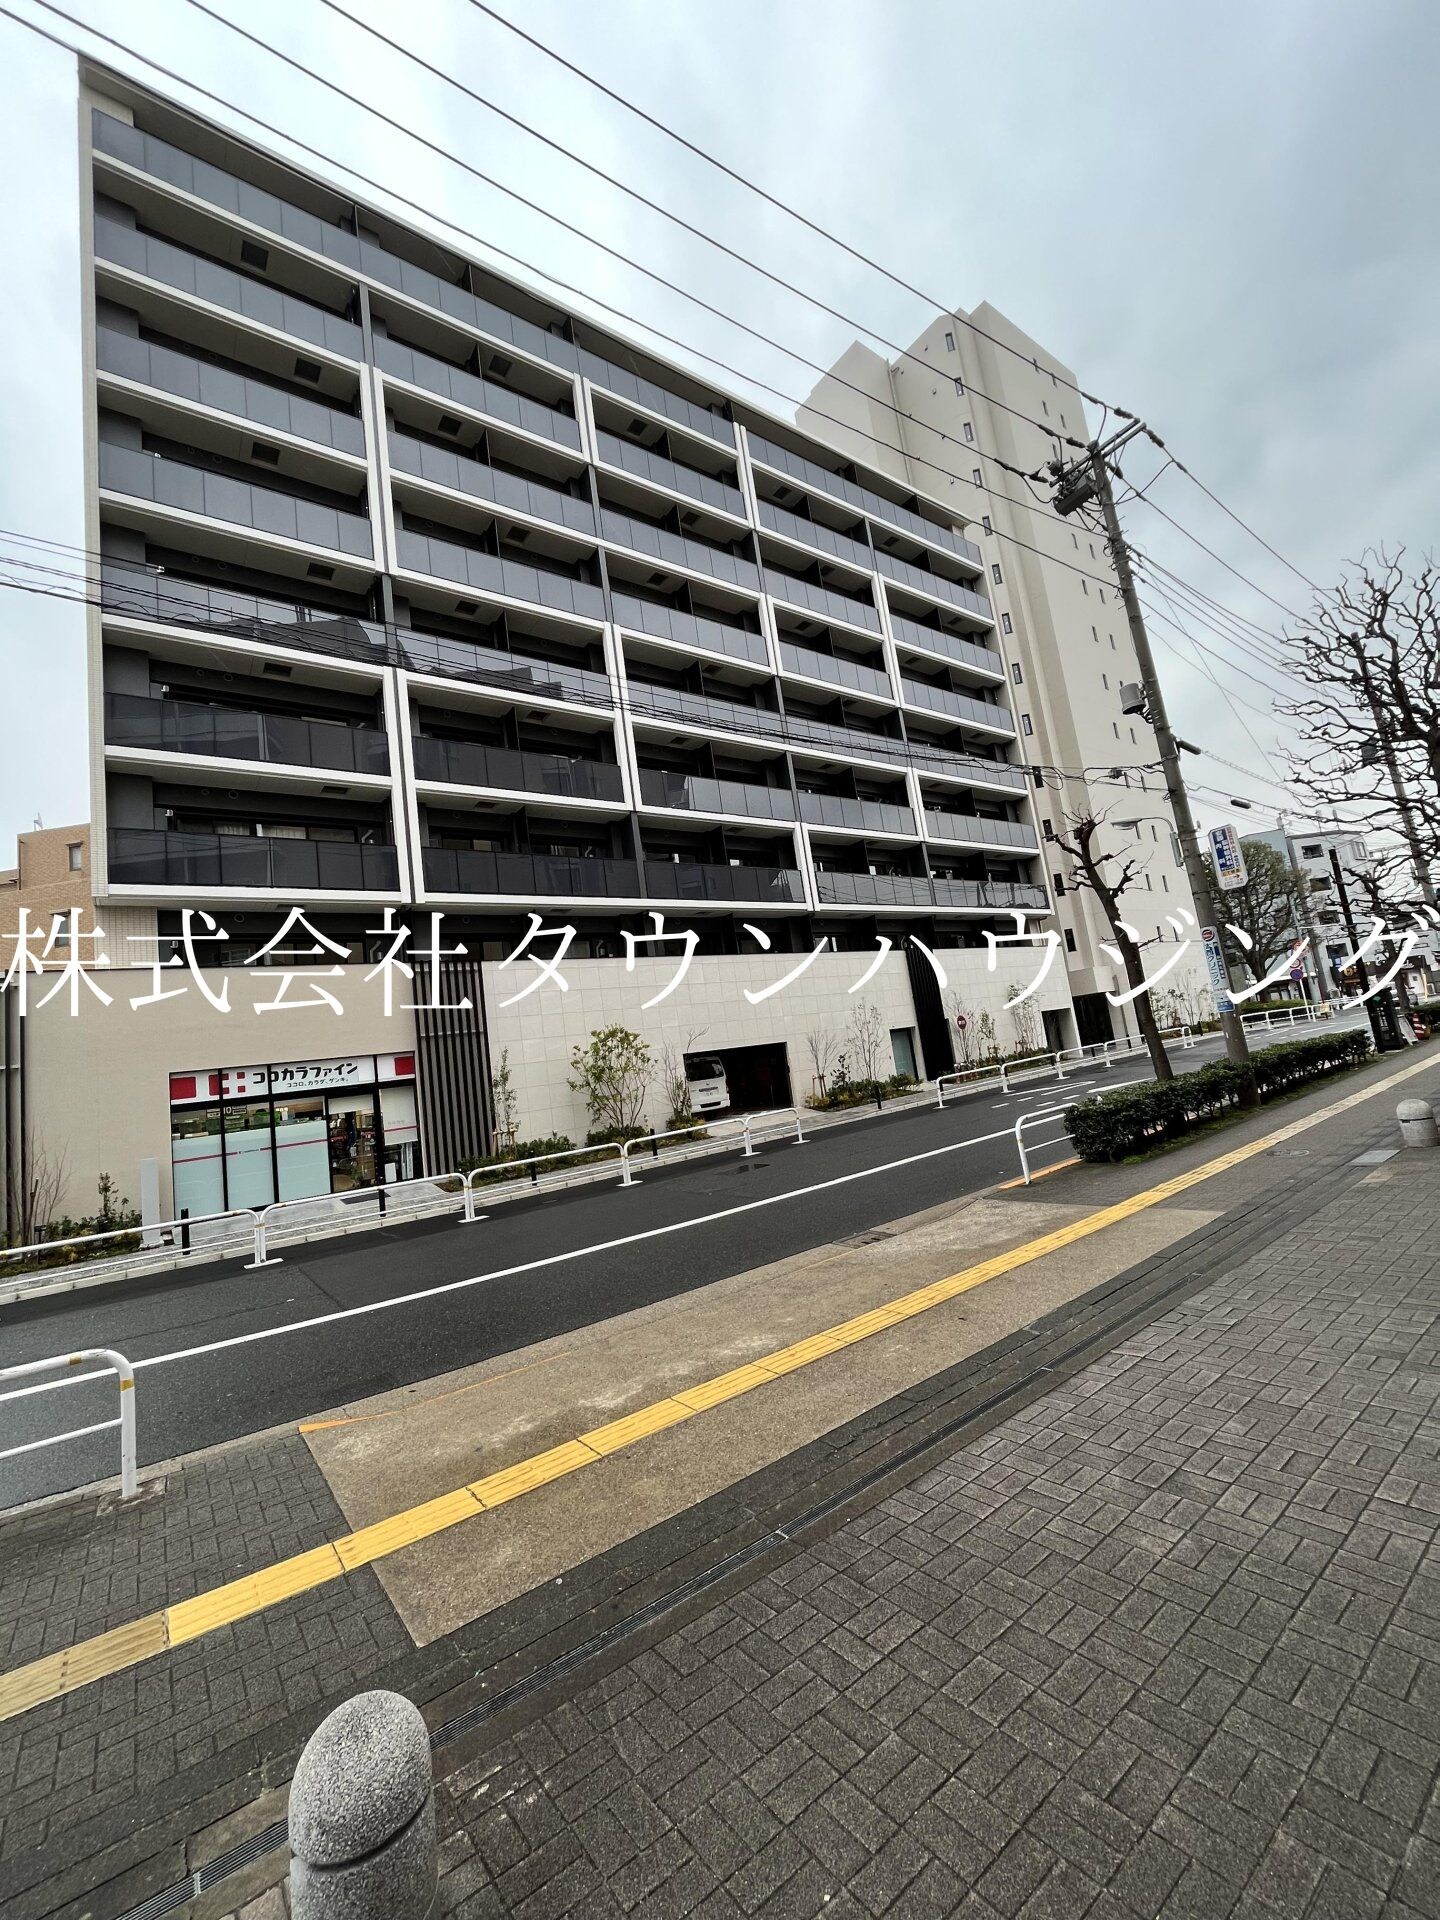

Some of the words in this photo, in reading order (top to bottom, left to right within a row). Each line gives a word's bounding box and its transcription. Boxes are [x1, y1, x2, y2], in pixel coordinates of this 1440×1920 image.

[252, 1062, 358, 1084] ココカラファイン
